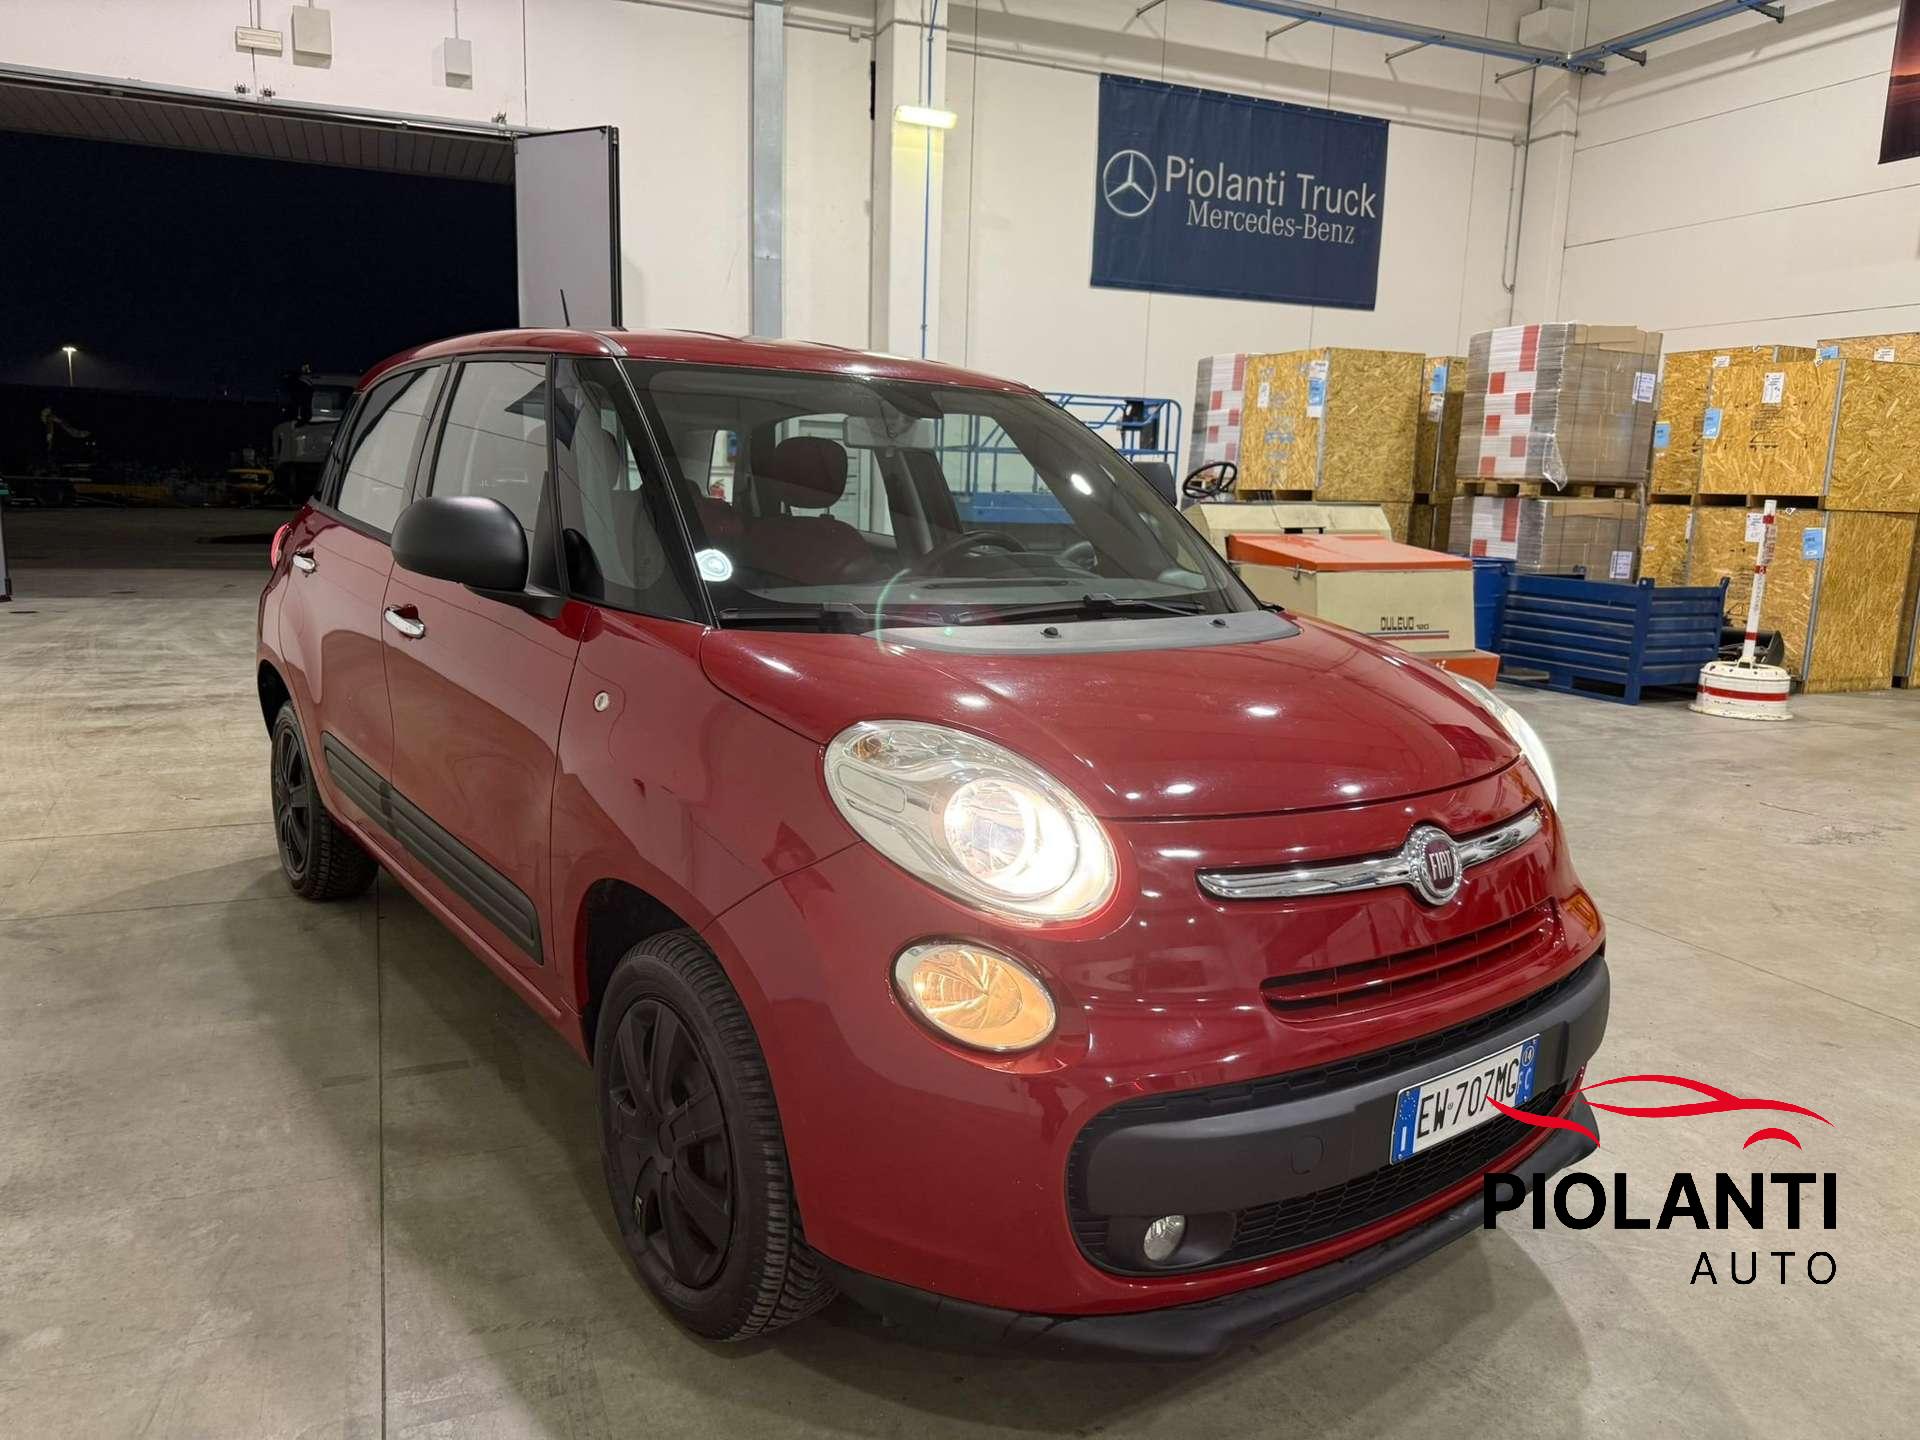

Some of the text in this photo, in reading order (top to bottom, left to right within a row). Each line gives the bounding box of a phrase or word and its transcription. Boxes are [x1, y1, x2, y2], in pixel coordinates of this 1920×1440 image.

[1165, 155, 1377, 219] Piolanti Truck
[1186, 199, 1356, 245] Mercedes-Benz
[1428, 849, 1453, 881] FIAT
